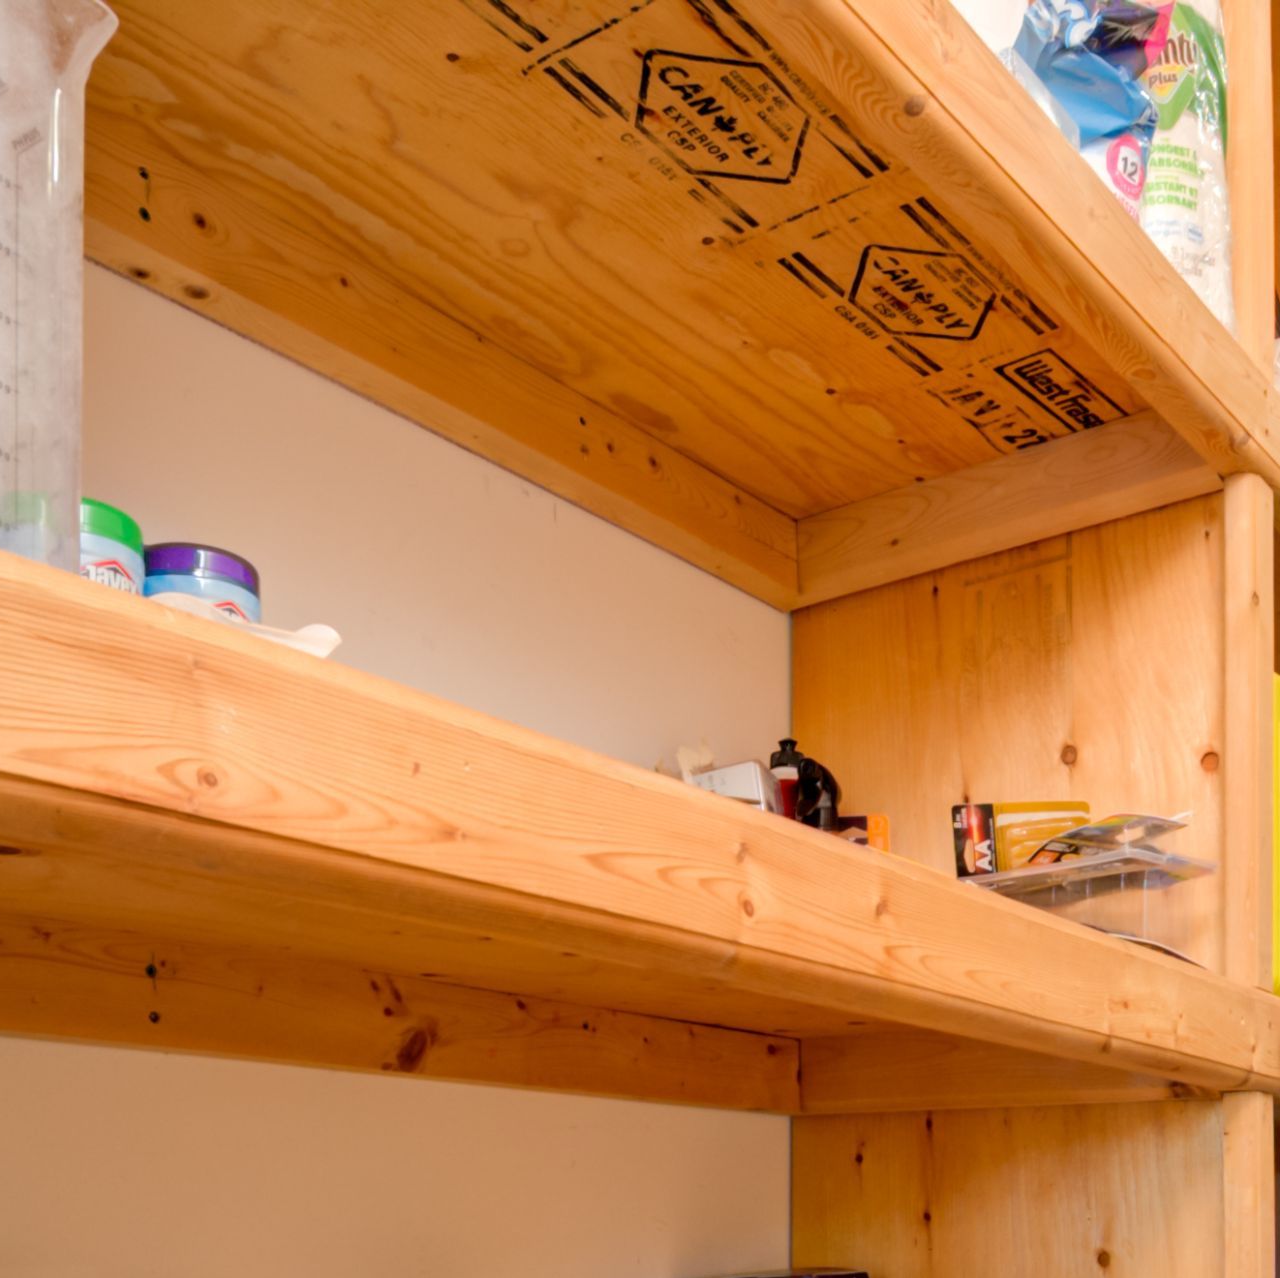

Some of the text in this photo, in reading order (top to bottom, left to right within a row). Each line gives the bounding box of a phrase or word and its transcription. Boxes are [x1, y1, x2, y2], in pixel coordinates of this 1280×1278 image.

[658, 66, 724, 116] CAN
[662, 104, 730, 163] EXTERIOR
[1121, 156, 1138, 183] 12
[929, 302, 971, 330] PLY
[1014, 359, 1069, 401] West
